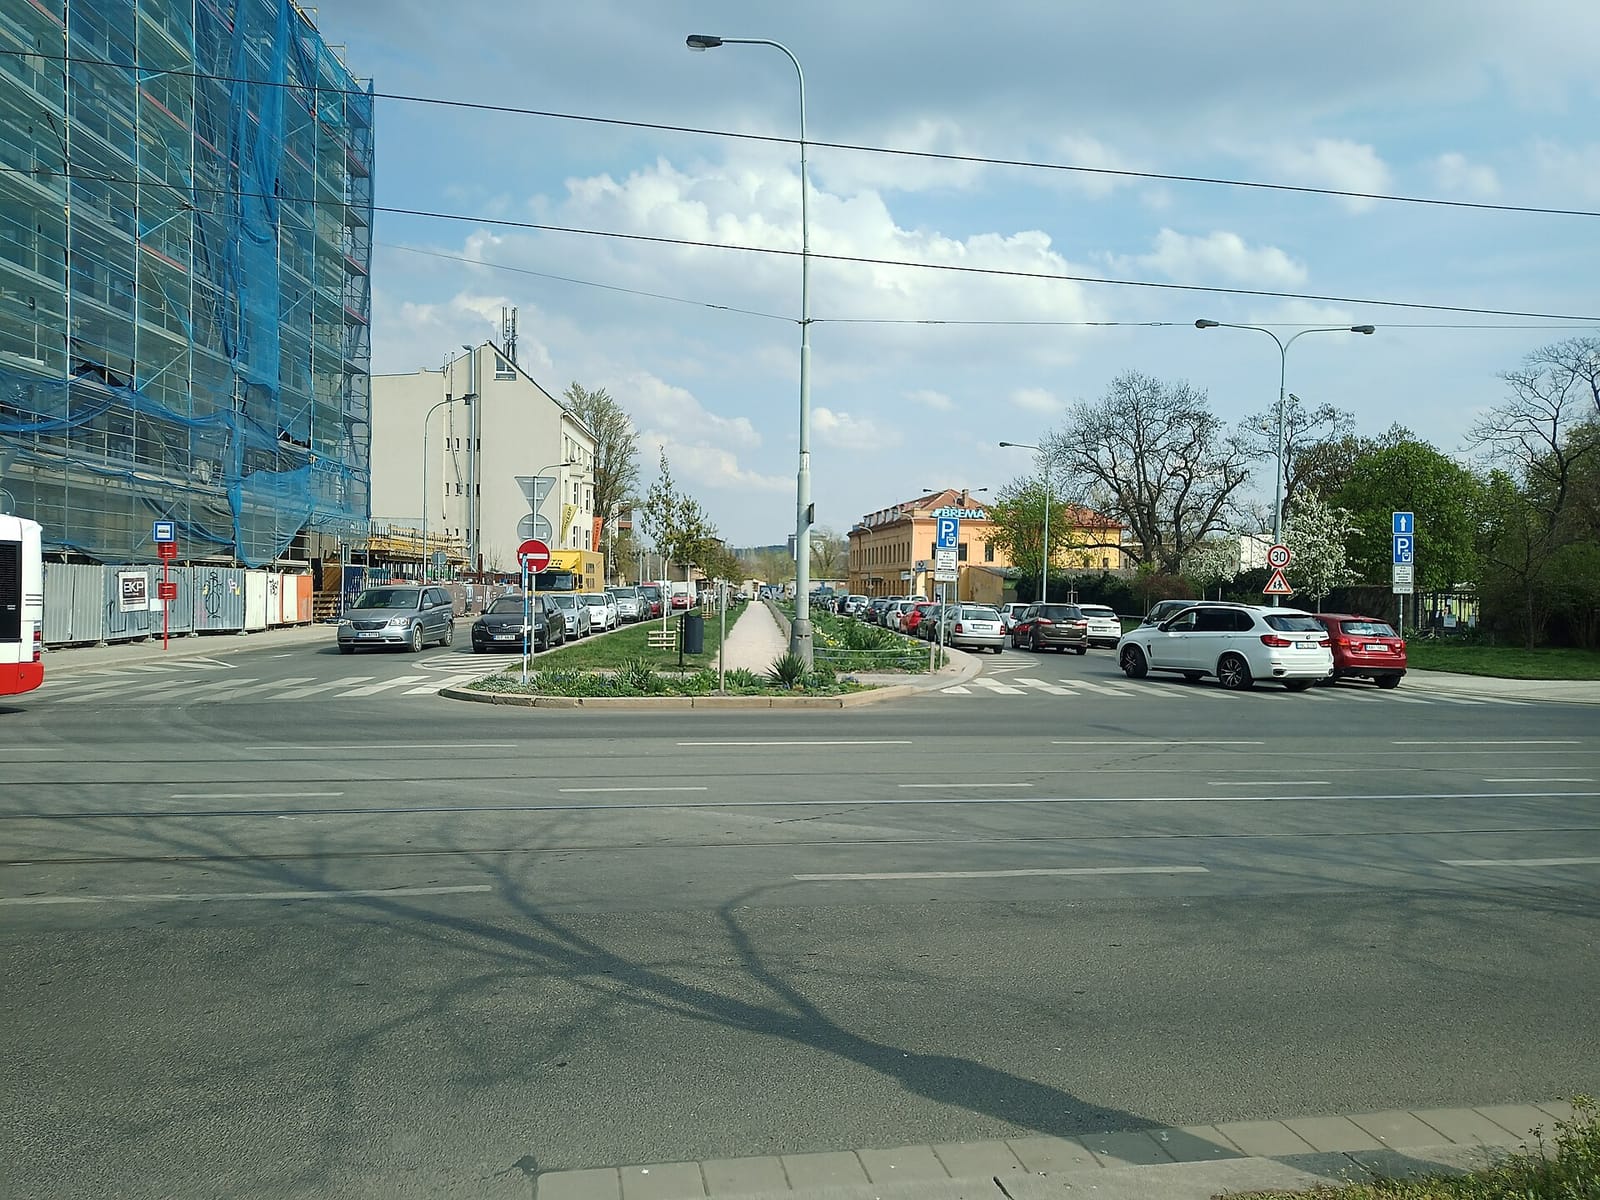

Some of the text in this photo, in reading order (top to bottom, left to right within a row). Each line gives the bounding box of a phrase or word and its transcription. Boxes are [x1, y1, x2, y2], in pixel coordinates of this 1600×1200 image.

[941, 520, 955, 539] P
[1397, 538, 1410, 555] P
[1272, 551, 1286, 562] 30
